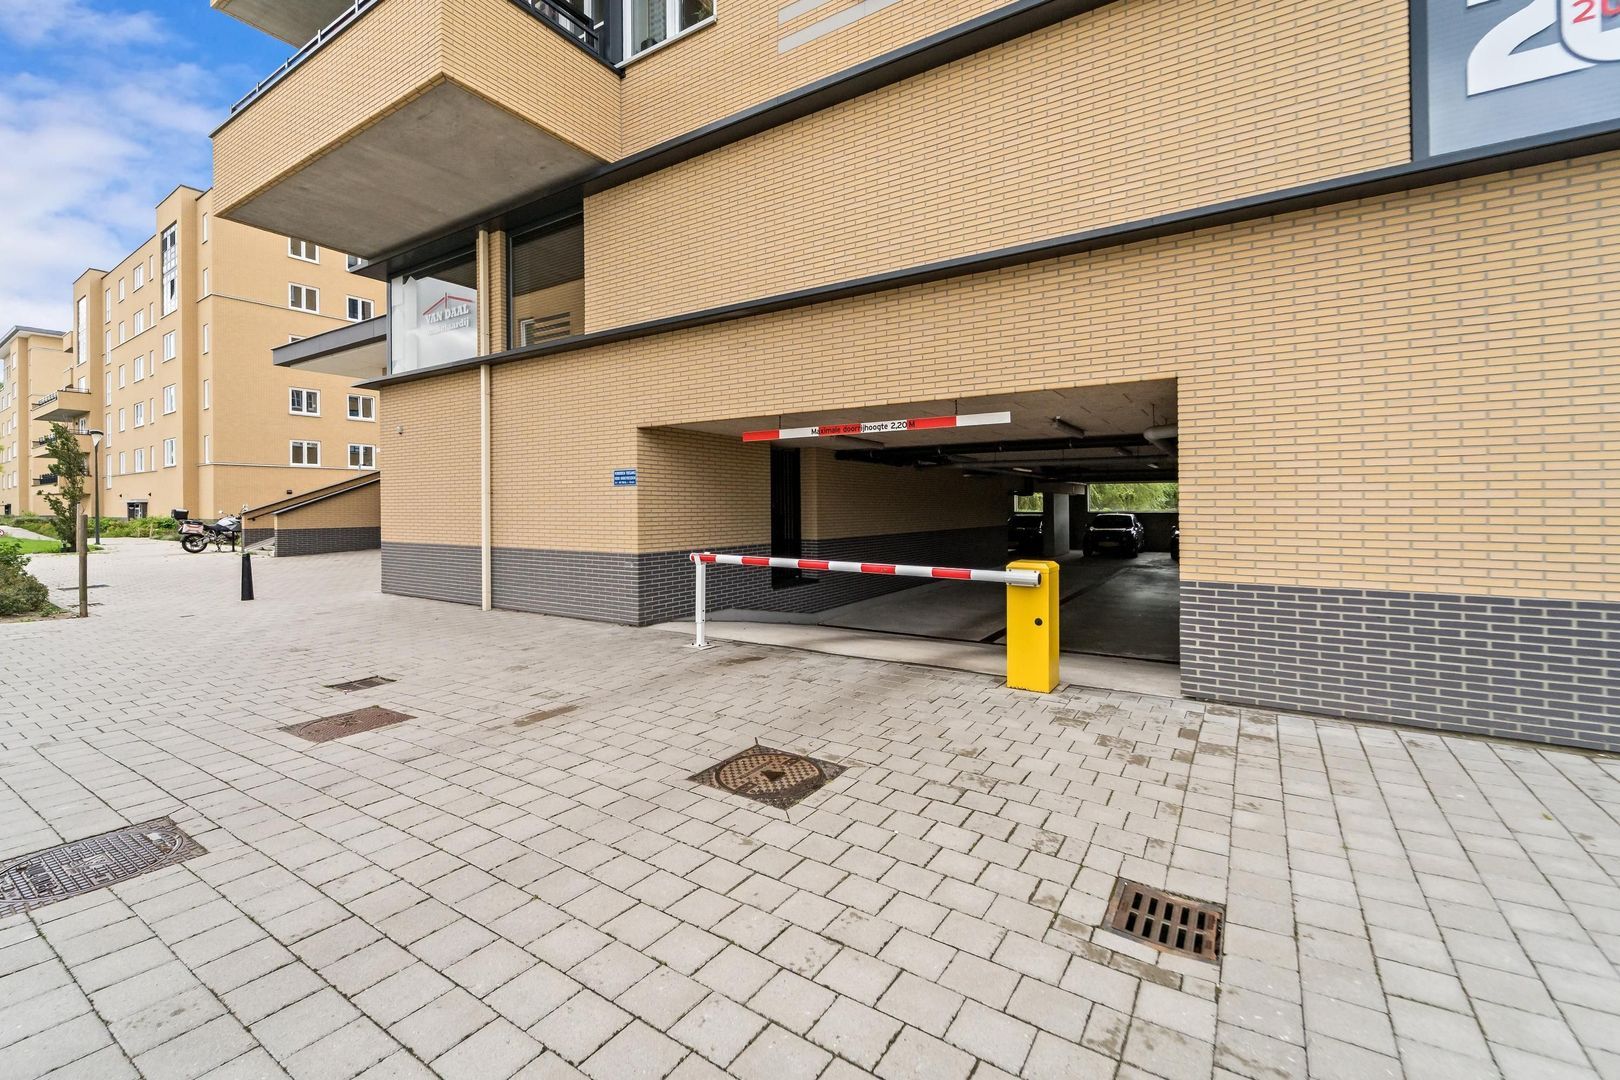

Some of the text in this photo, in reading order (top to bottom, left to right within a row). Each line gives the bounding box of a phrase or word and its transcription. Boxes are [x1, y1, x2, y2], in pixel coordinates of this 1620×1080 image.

[425, 303, 469, 323] VAN DAAL
[811, 426, 841, 435] Maximale
[844, 422, 888, 433] doorrijhoogte
[890, 421, 907, 430] 2,20
